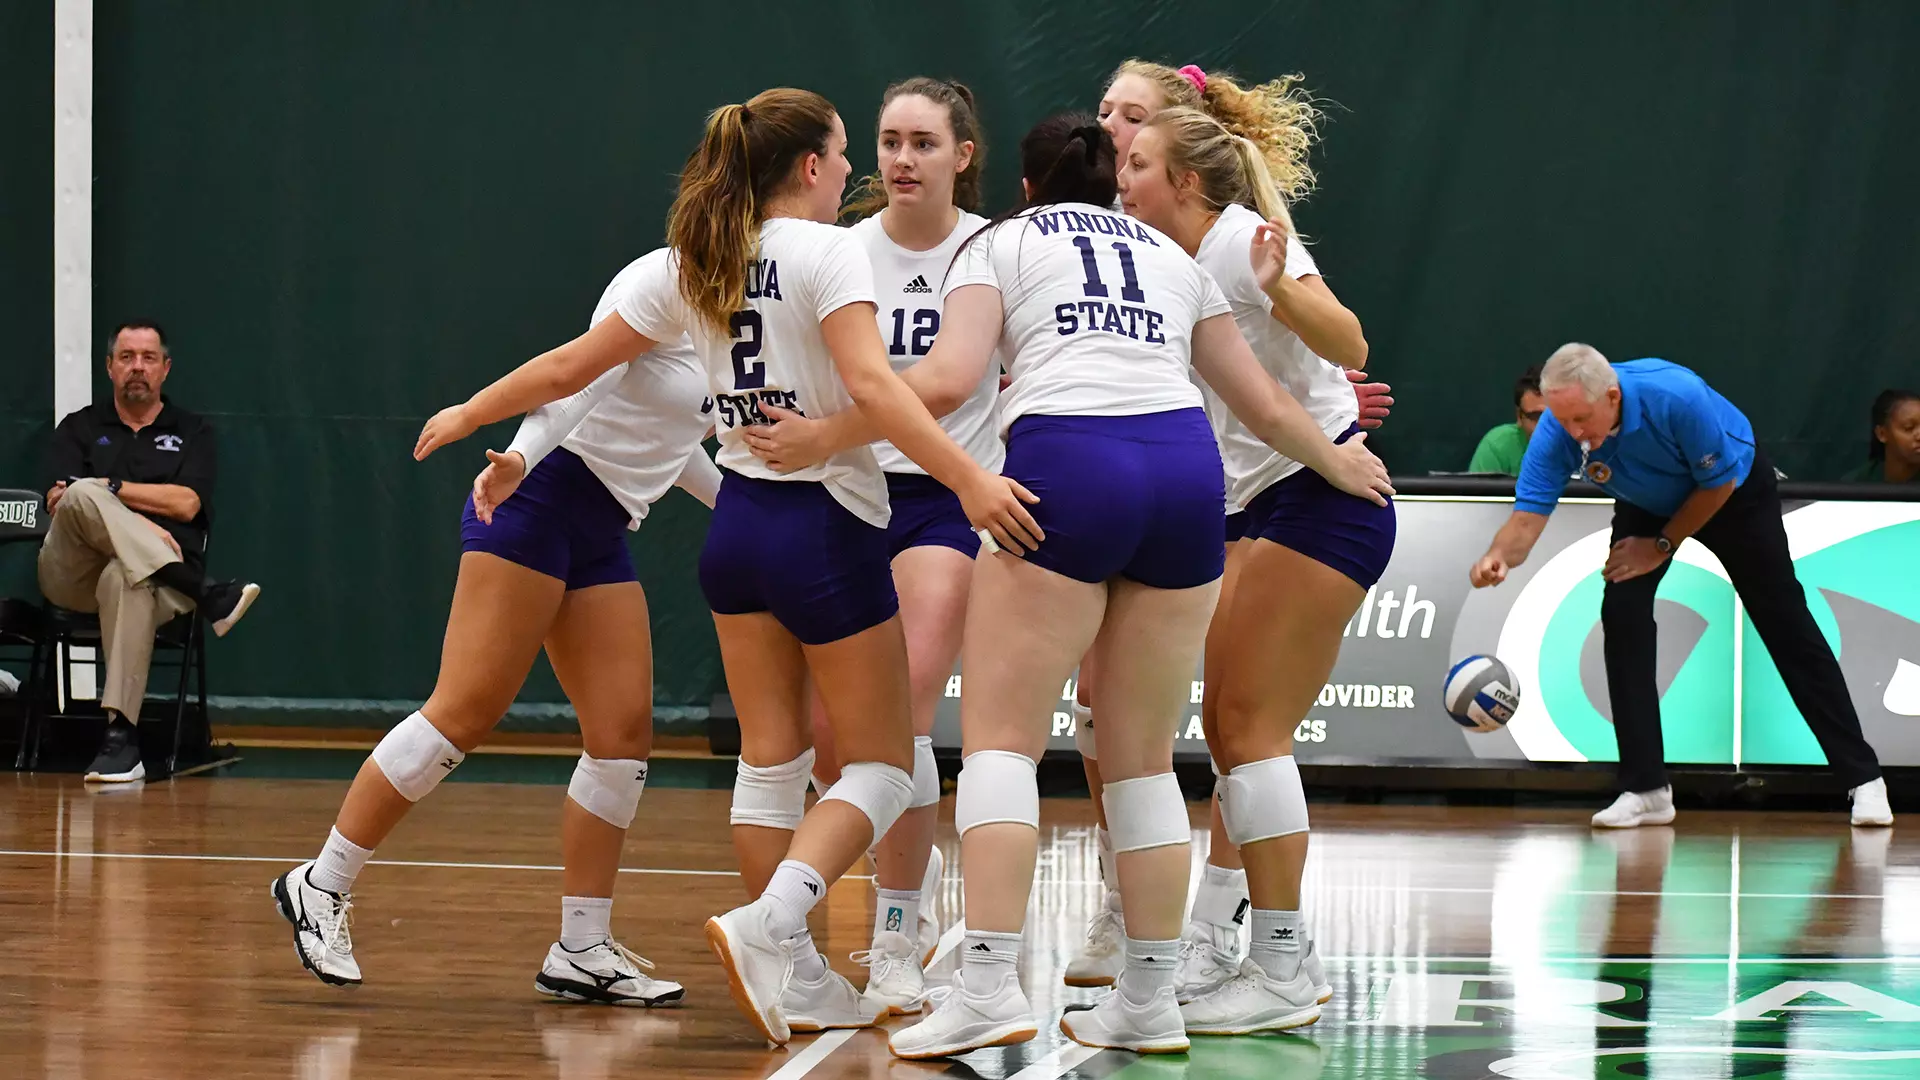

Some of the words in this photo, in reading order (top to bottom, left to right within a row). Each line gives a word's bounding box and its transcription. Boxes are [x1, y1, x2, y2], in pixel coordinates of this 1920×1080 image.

[1031, 210, 1161, 247] WINONA
[903, 286, 933, 294] adidas
[1072, 235, 1146, 304] 11
[889, 308, 941, 356] 12
[1055, 301, 1166, 345] STATE
[729, 309, 766, 390] 2
[1343, 584, 1437, 639] lth
[1313, 683, 1415, 709] OVIDER
